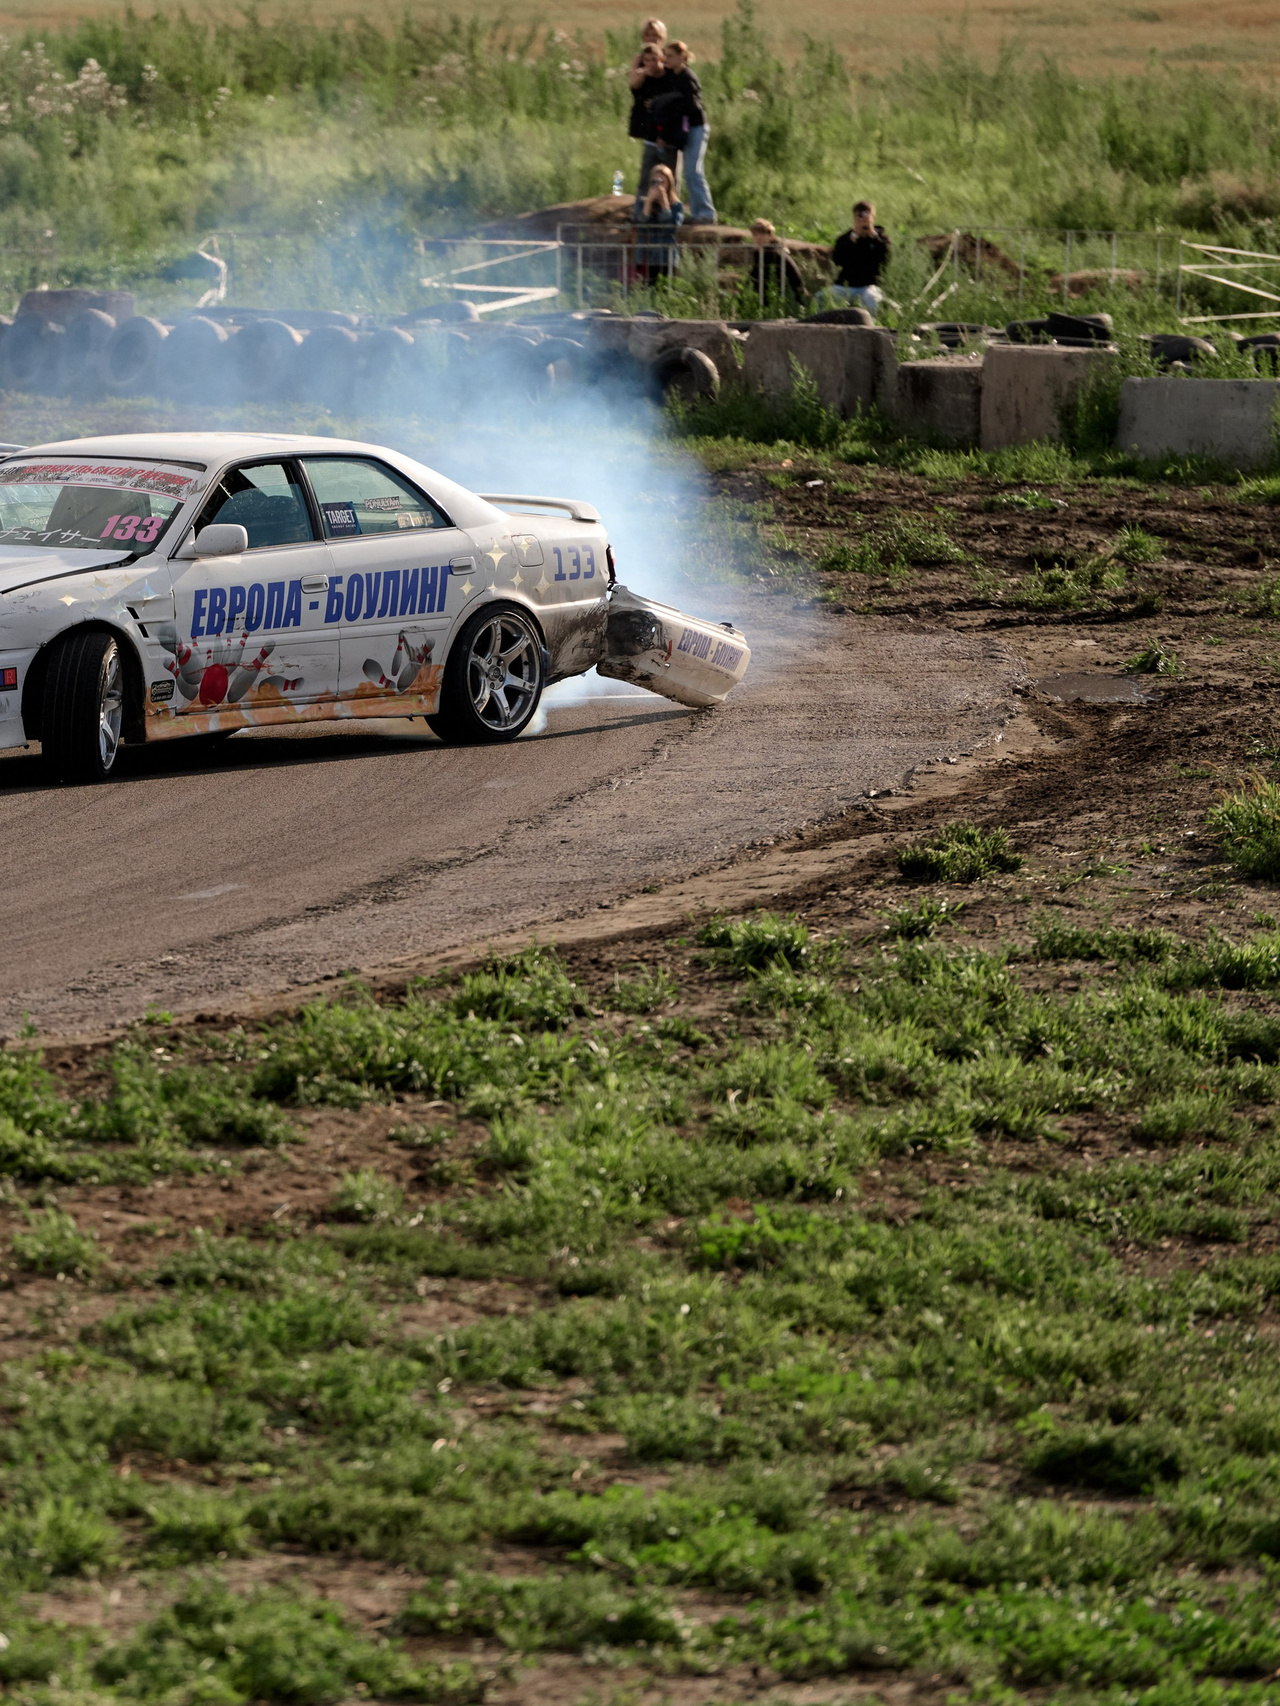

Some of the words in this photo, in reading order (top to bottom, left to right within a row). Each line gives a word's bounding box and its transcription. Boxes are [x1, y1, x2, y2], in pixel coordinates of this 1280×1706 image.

[100, 514, 164, 543] 133
[326, 509, 356, 524] TARGET
[553, 545, 595, 581] 133
[191, 580, 302, 637] ЕВРОПА
[324, 565, 453, 623] БОУЛИНГ
[677, 627, 712, 660] ЕВРОПА
[711, 641, 744, 672] БОУЛИНГ
